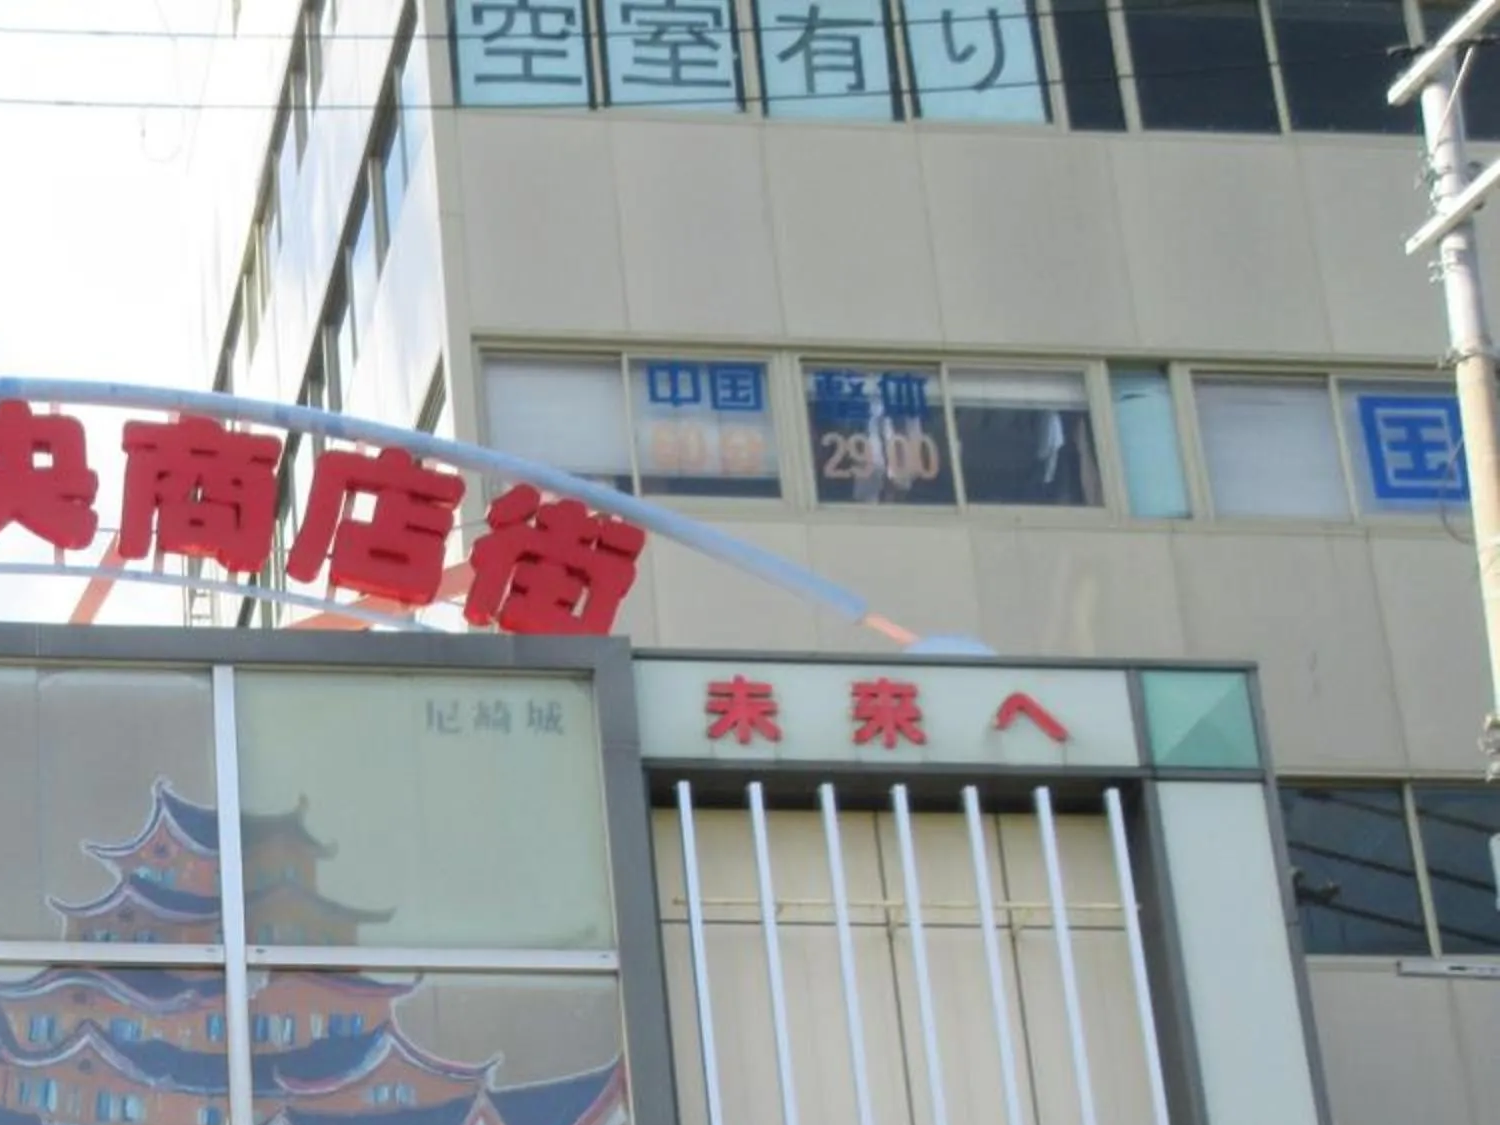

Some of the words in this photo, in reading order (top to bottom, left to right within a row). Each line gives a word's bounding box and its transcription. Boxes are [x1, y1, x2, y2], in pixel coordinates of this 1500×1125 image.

[471, 0, 1007, 93] 空室有り
[648, 362, 764, 411] 中国
[704, 674, 1069, 750] 未来へ
